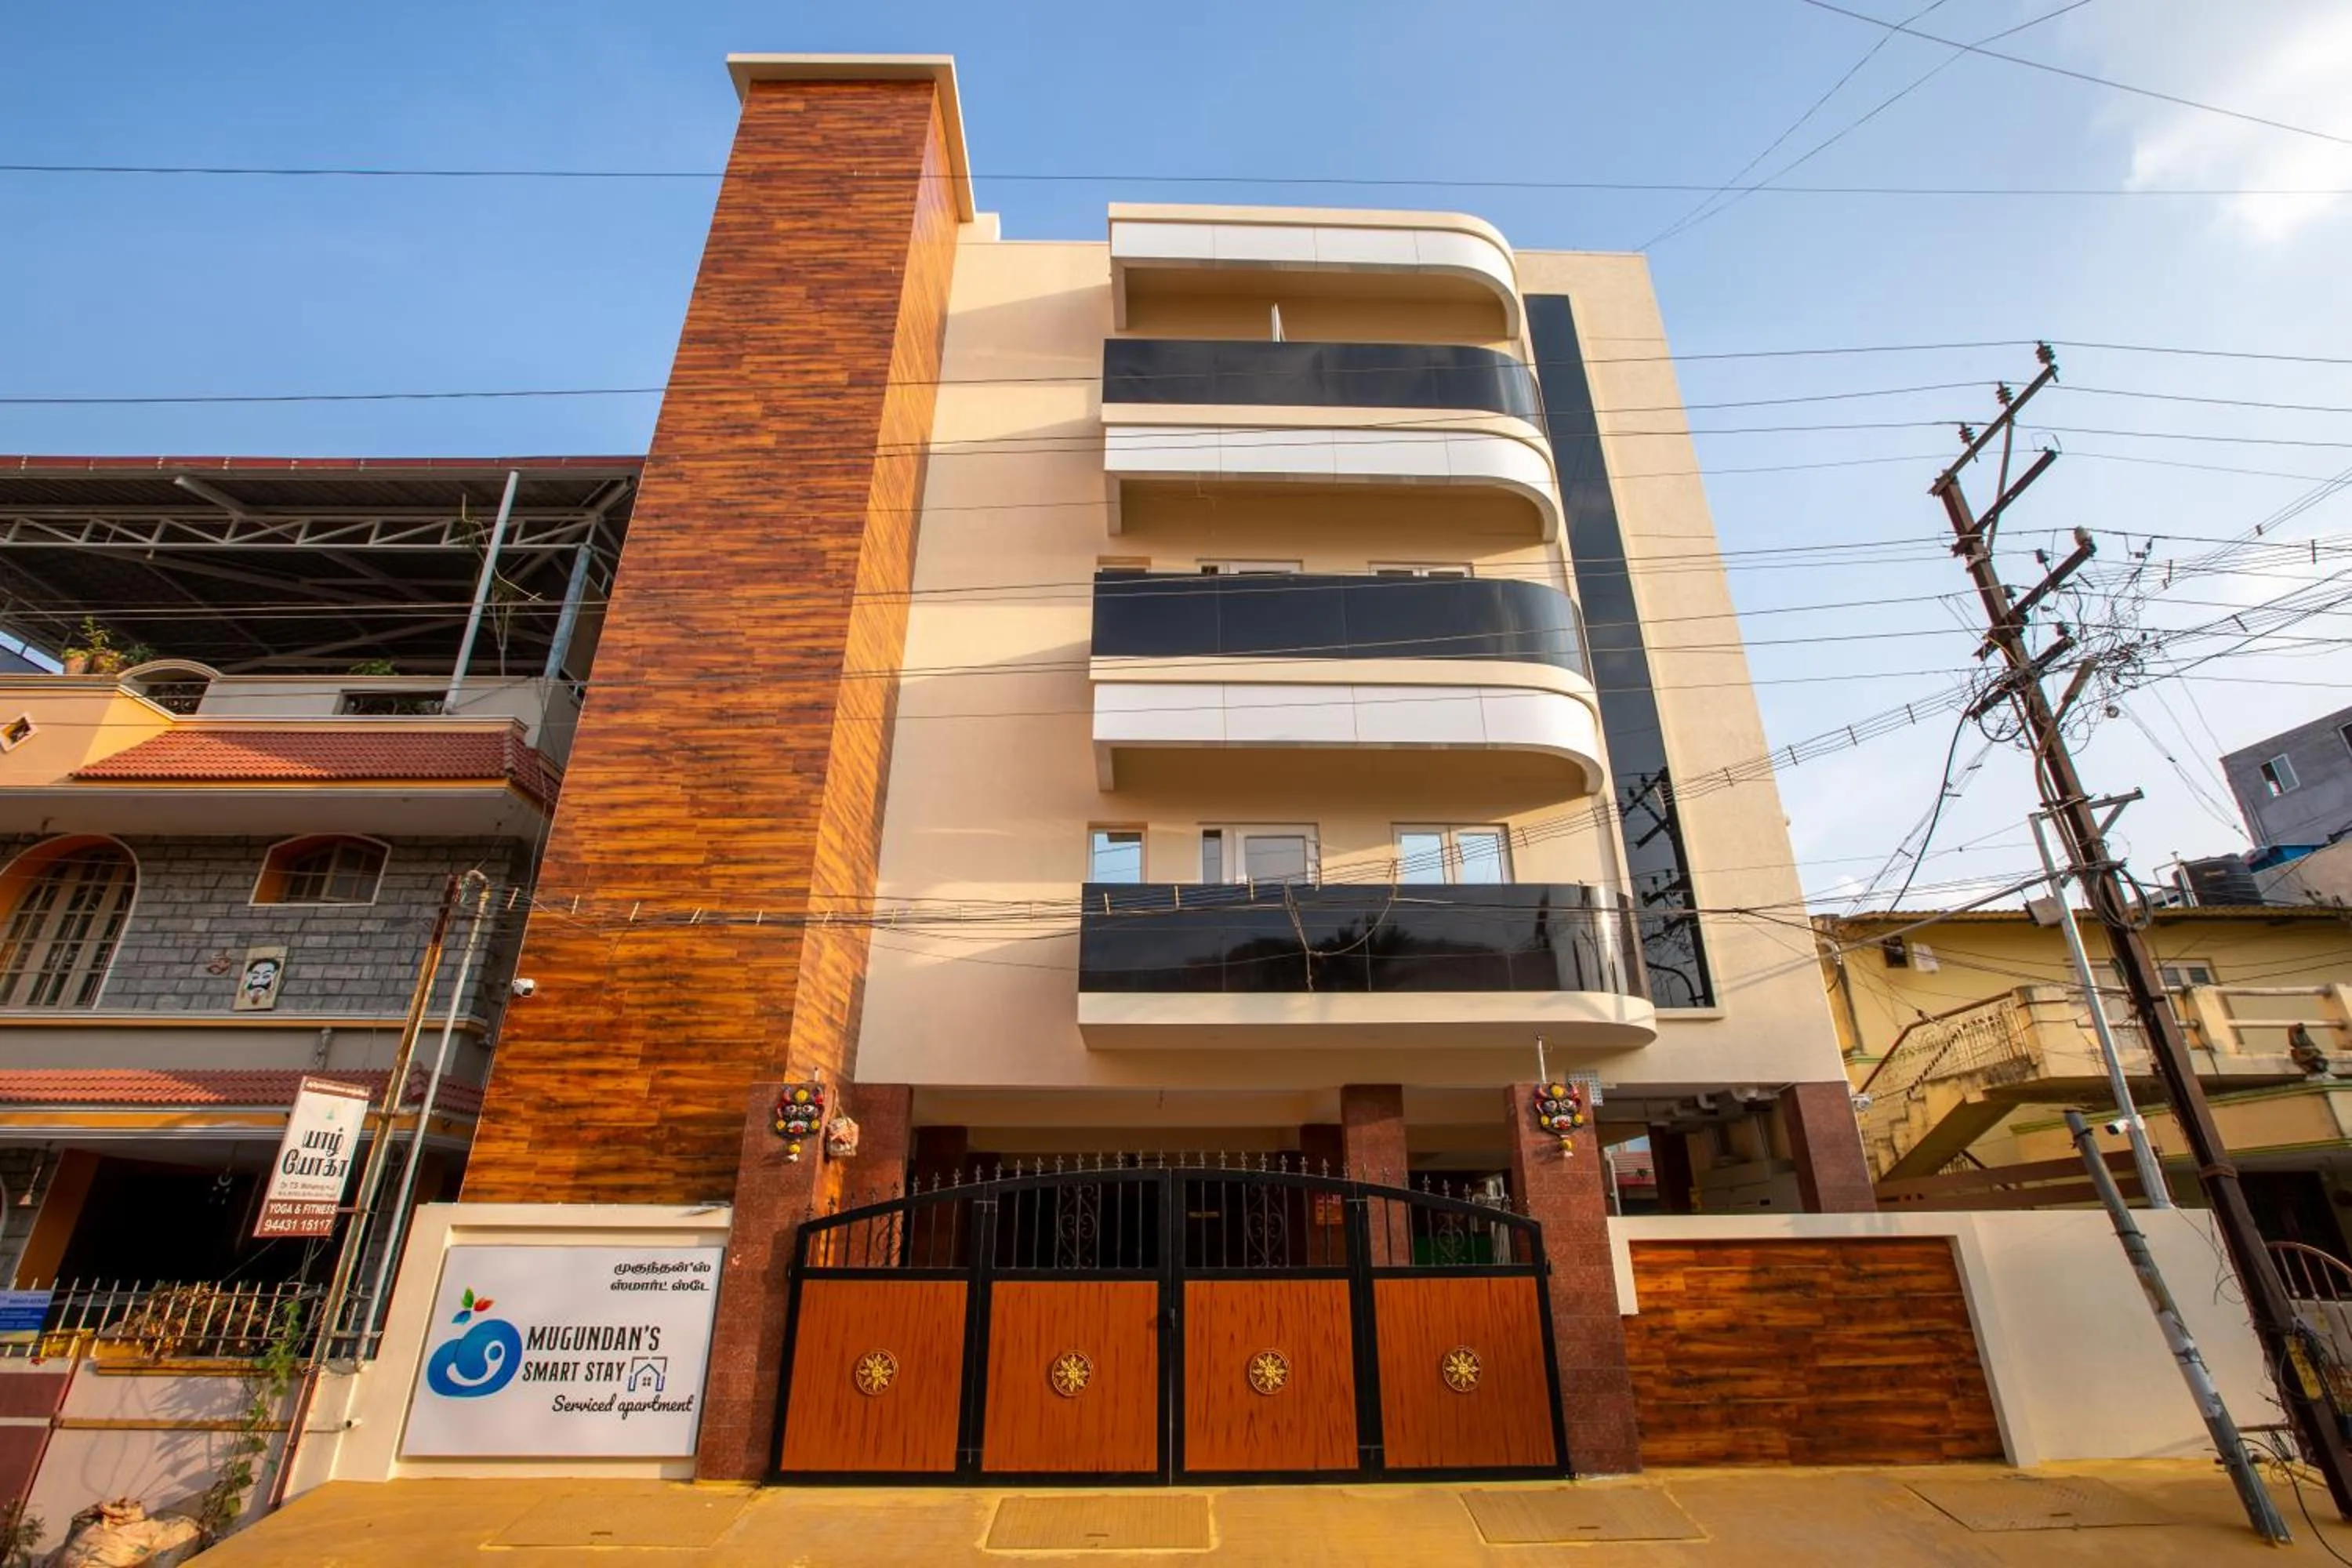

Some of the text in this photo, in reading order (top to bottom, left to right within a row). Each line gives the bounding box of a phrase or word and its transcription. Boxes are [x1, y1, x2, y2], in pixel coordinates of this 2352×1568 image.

[302, 1127, 343, 1157] யாழ்
[282, 1149, 348, 1178] யோகா
[270, 1203, 336, 1215] YOGA & FITNESS
[263, 1219, 332, 1232] 94431 15117
[672, 1279, 710, 1291] ஸ்டே
[526, 1326, 661, 1351] MUGUNDAN'S
[522, 1362, 626, 1382] SMART STAY
[552, 1393, 694, 1420] Serviced apartment
